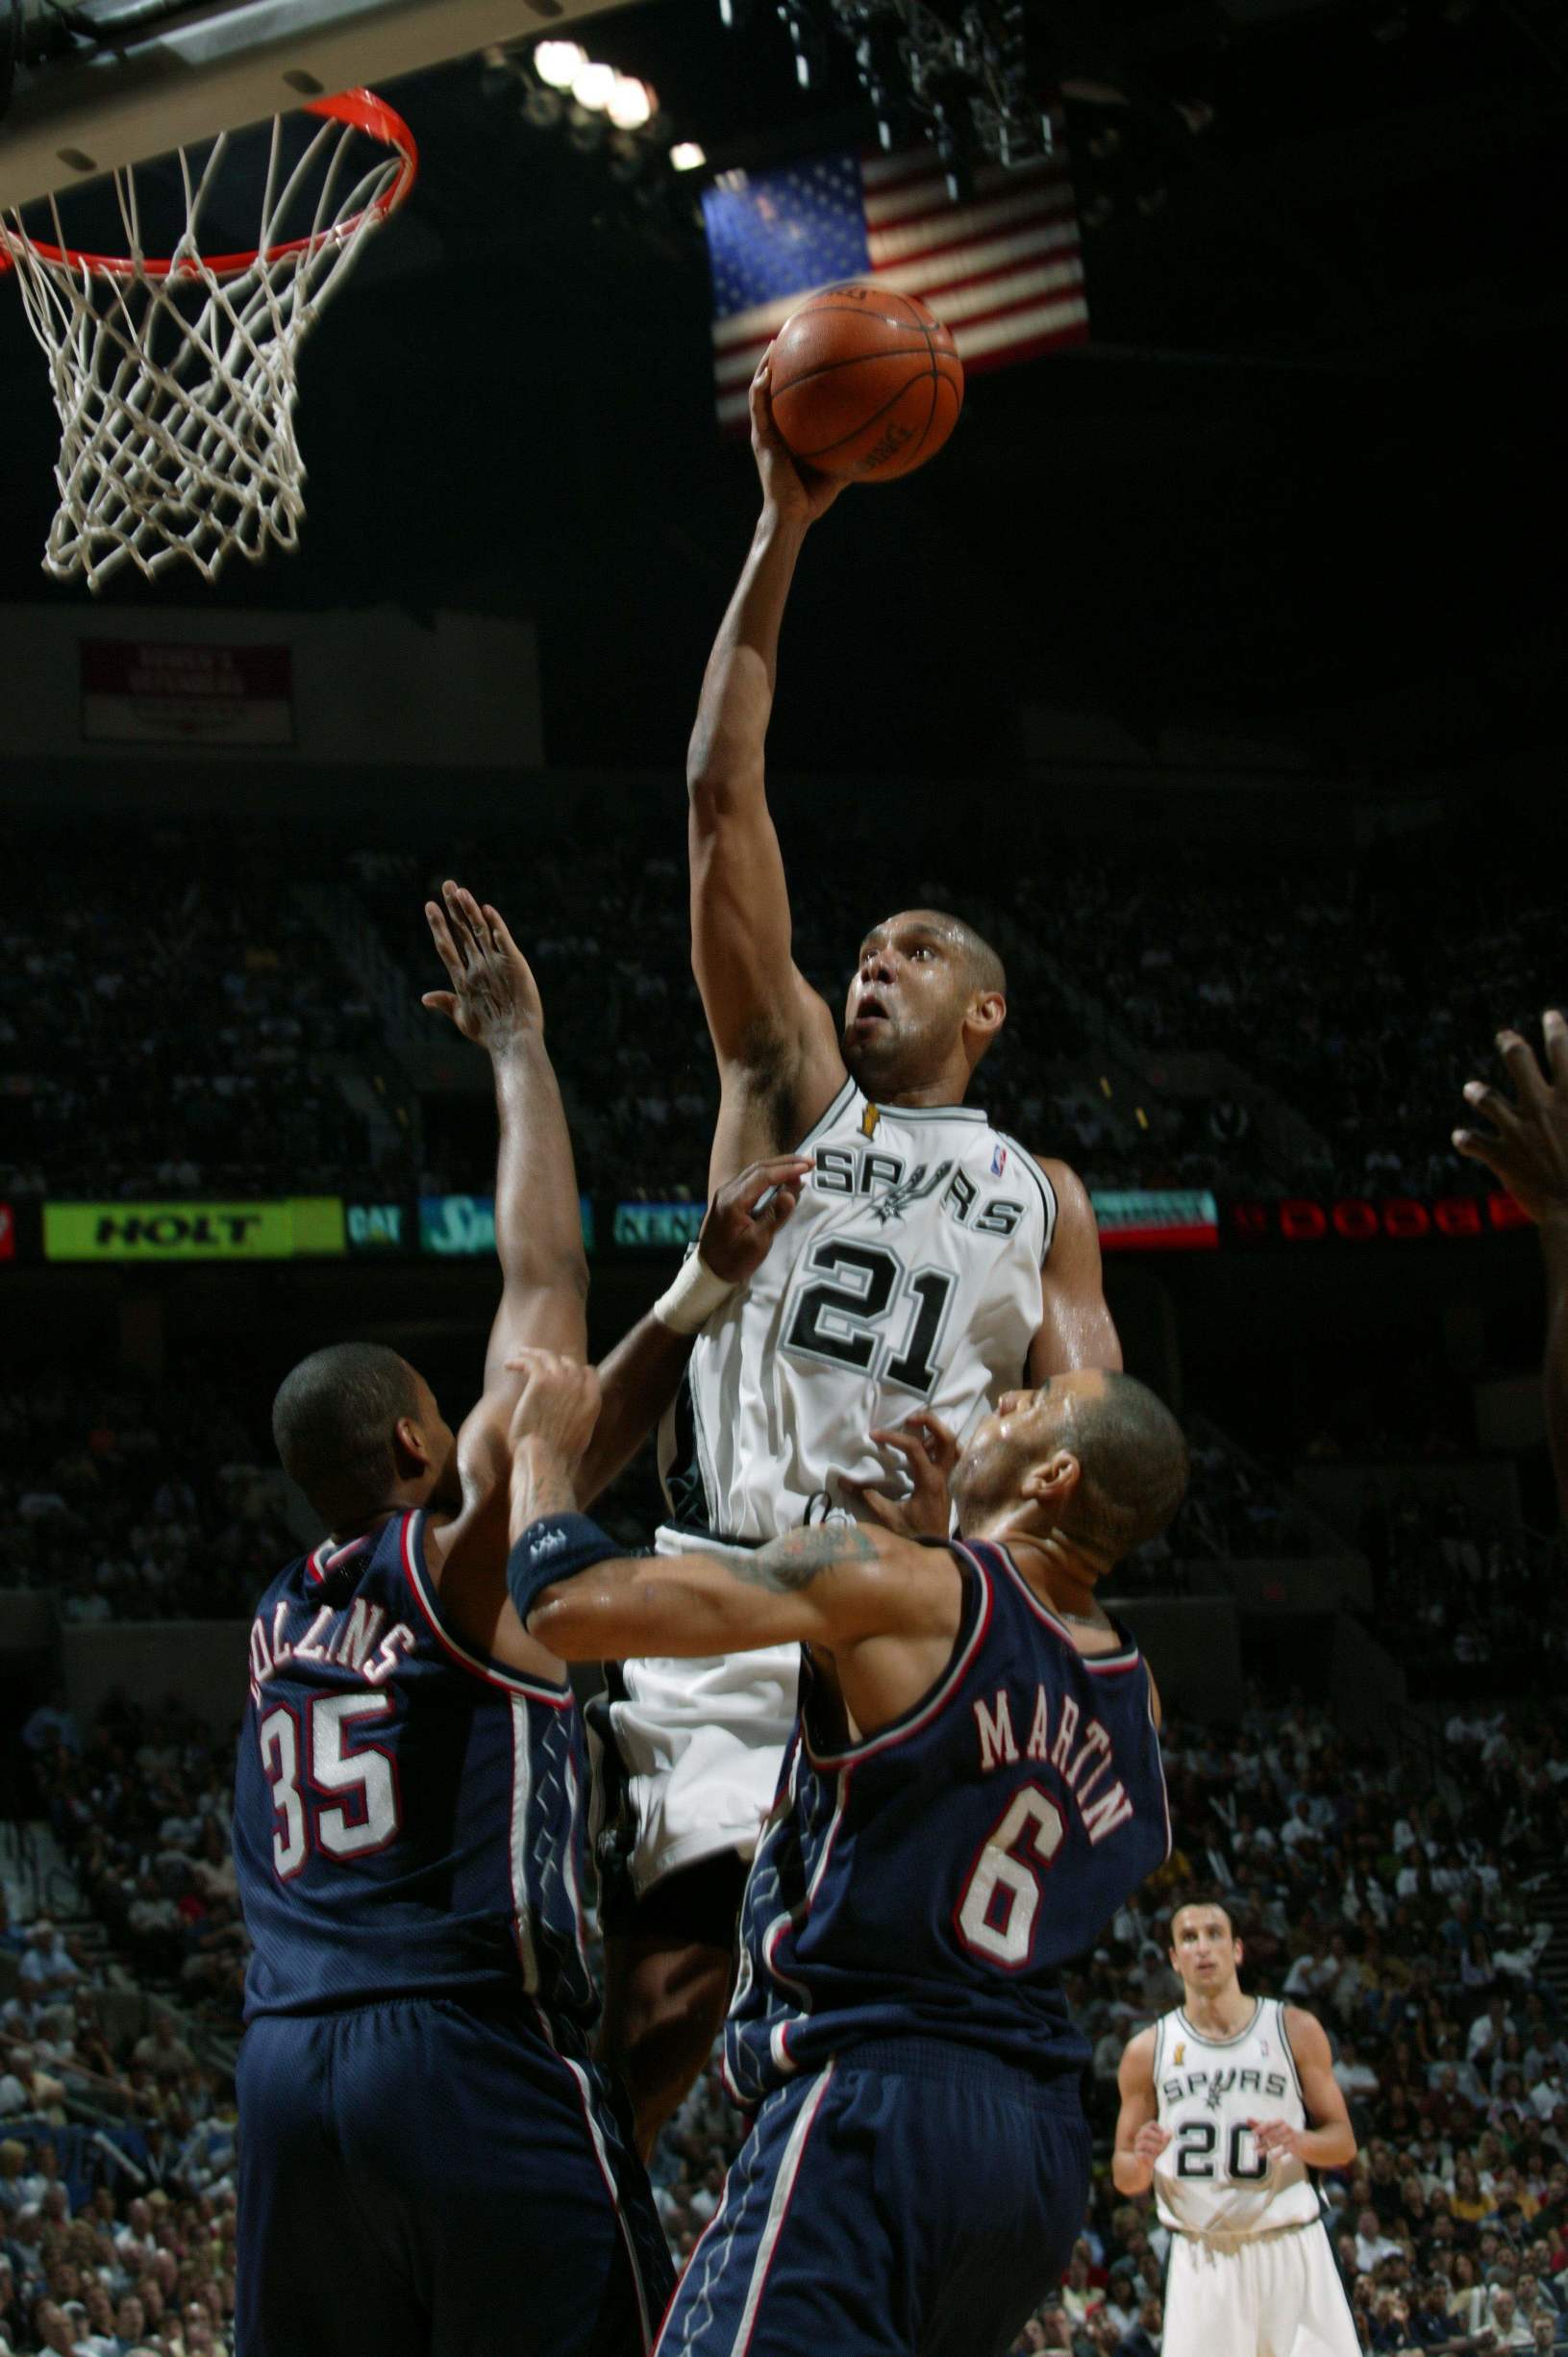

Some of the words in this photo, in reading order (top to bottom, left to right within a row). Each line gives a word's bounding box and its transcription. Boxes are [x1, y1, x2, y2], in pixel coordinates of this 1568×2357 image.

[95, 1214, 261, 1247] HOLT
[812, 1145, 1026, 1238] SPURS
[778, 1238, 958, 1398] 21
[261, 1689, 404, 1882] 35
[972, 1683, 1134, 1846] MARTIN
[953, 1778, 1070, 1972] 6
[1162, 2068, 1288, 2111] SPURS
[1175, 2120, 1271, 2182] 20
